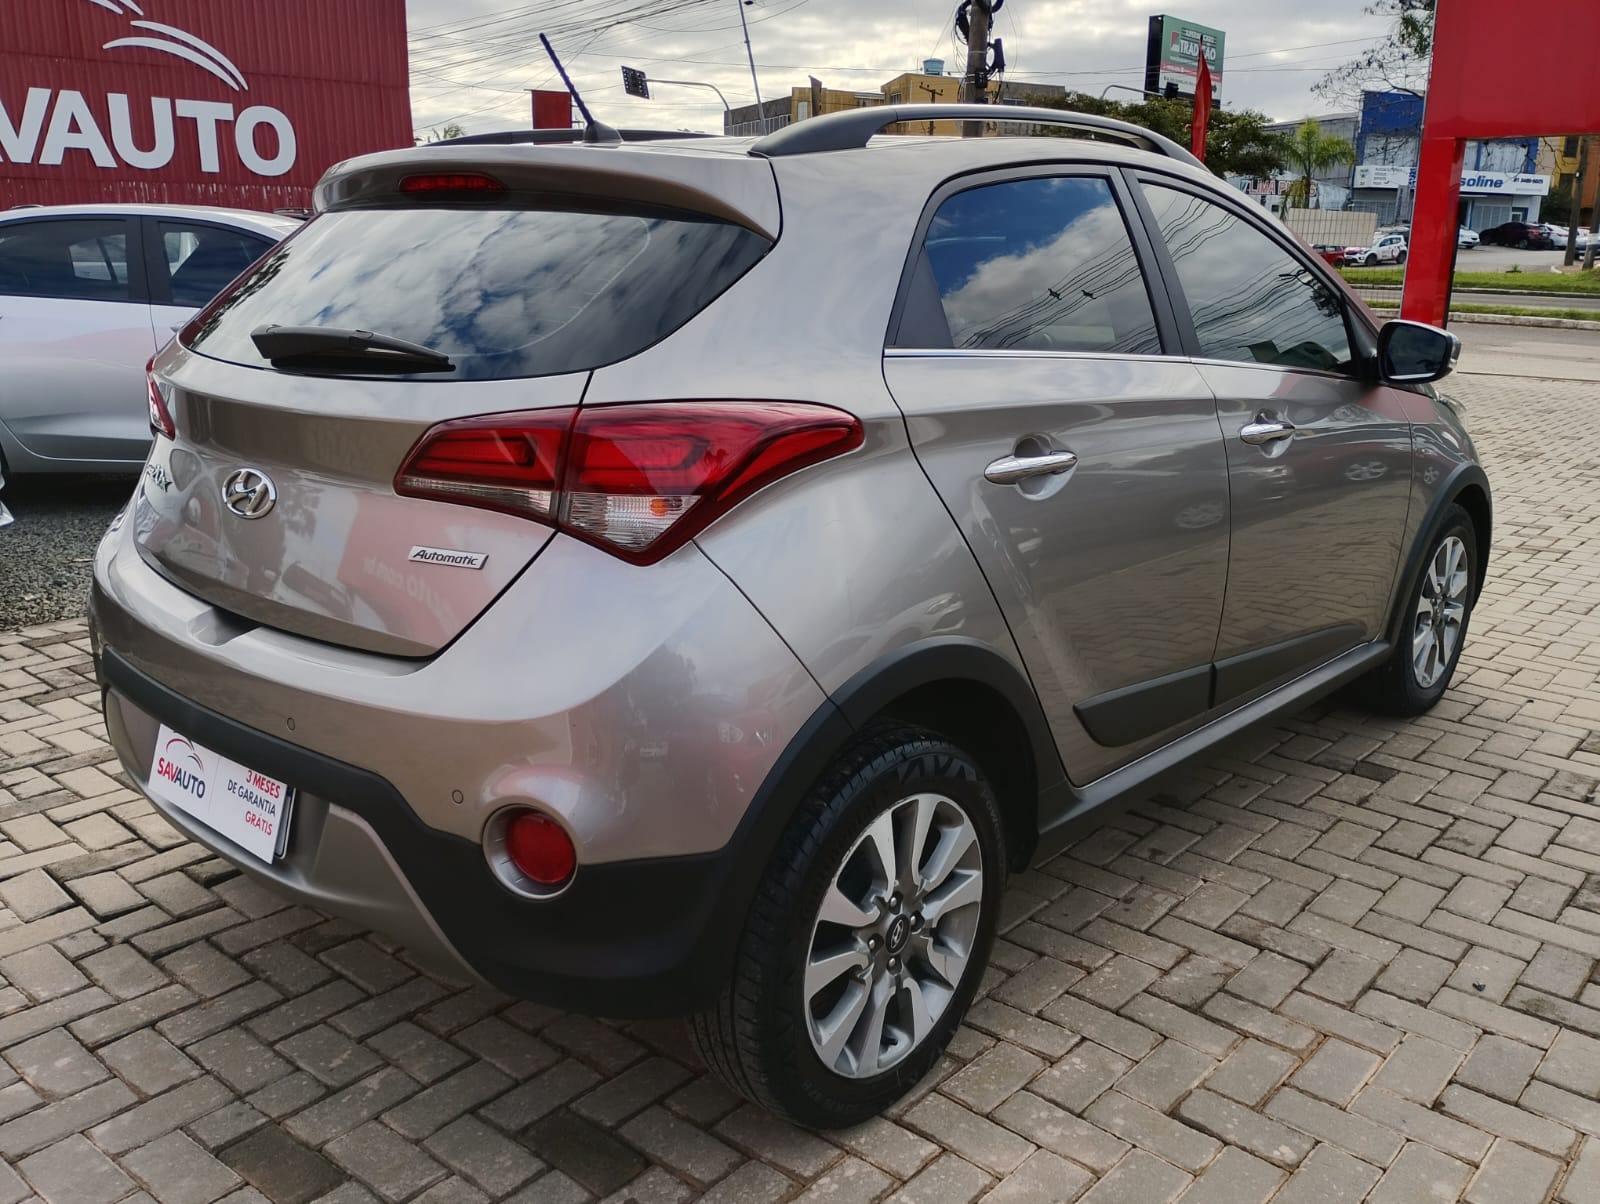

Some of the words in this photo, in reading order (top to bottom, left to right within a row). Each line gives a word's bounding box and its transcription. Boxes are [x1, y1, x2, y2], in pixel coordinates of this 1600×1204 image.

[0, 87, 297, 177] VAUTO
[412, 549, 479, 566] Automatic
[157, 757, 206, 799] SAVAUTO
[246, 769, 252, 783] 3
[252, 774, 281, 799] MESES
[227, 779, 238, 794] DE
[238, 787, 276, 817] GARANTIA
